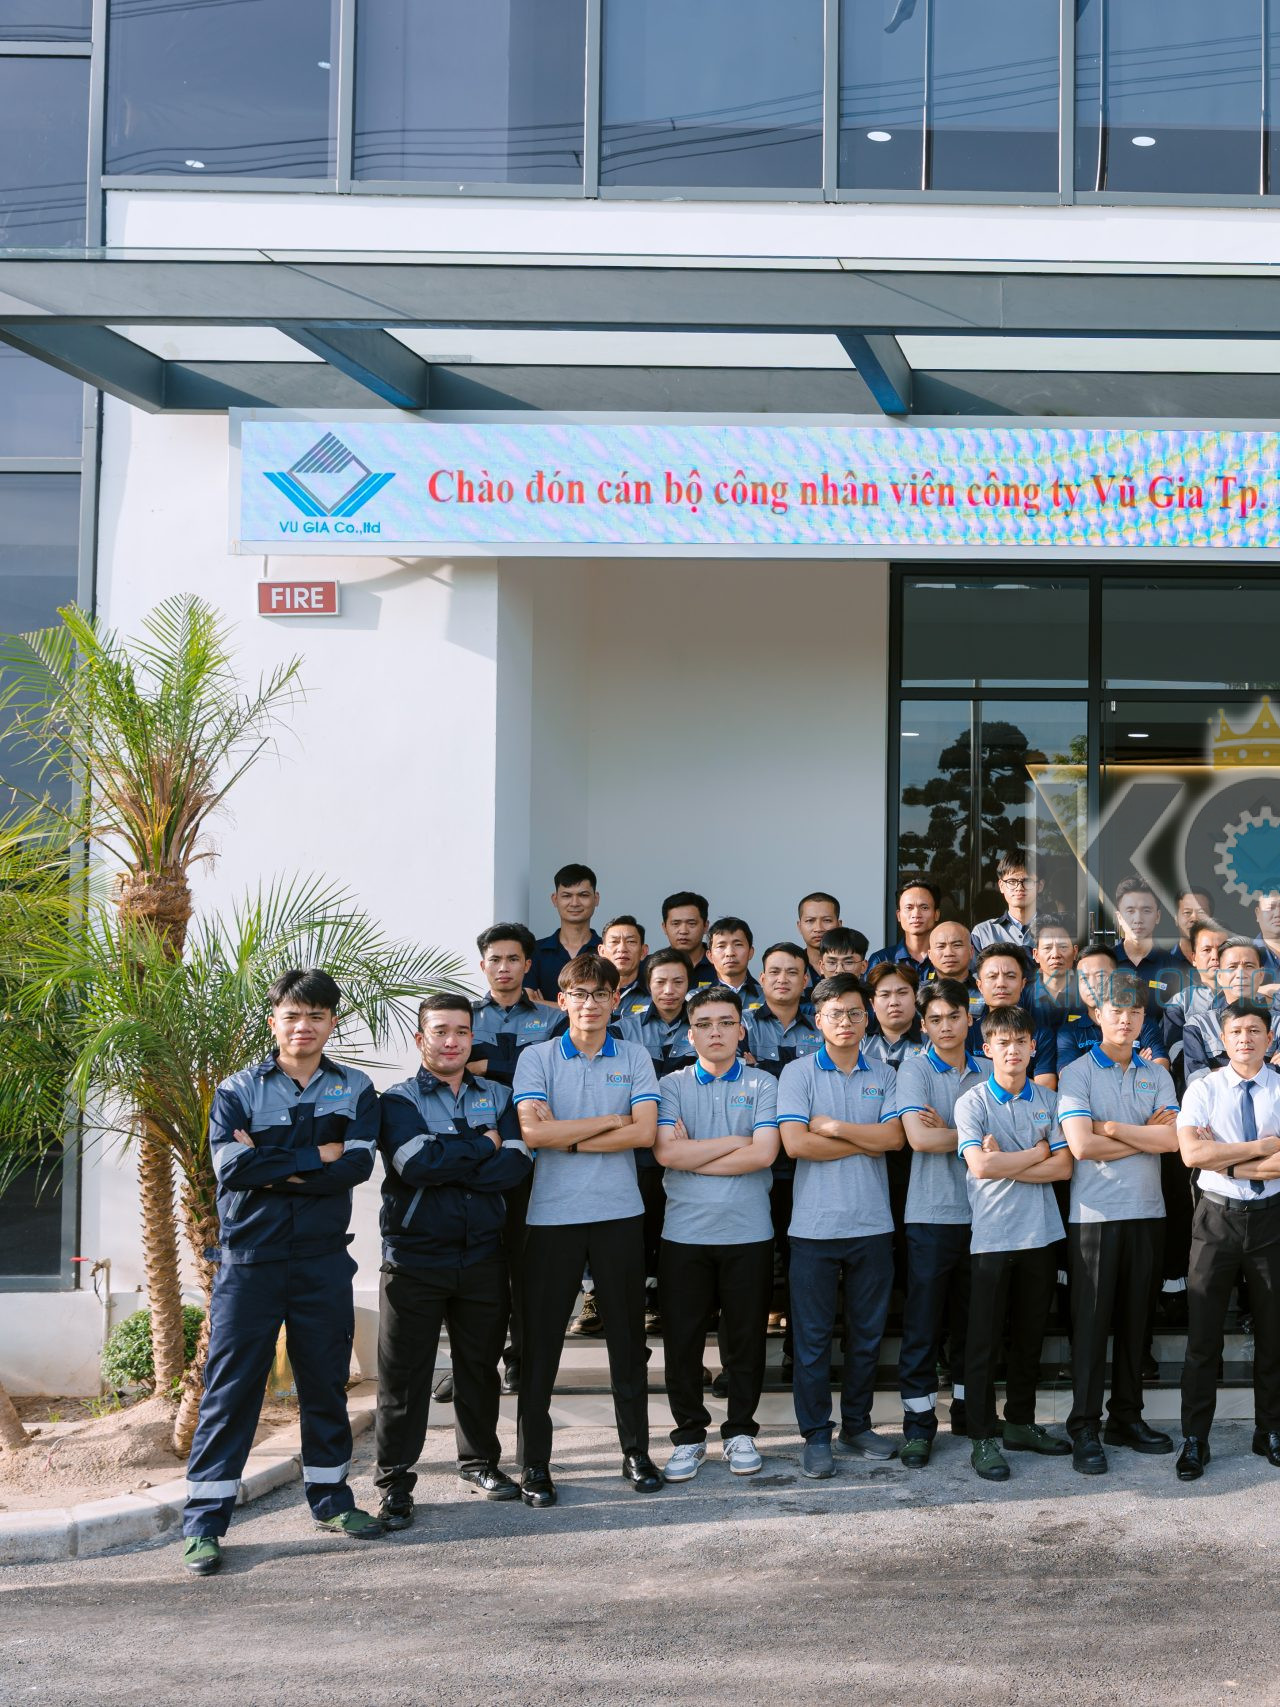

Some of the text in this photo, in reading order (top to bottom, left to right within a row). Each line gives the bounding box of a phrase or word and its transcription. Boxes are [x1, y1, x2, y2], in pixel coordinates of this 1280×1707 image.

[427, 469, 515, 503] Chào
[525, 469, 586, 505] đón
[597, 470, 653, 506] cán
[664, 469, 703, 513] bộ
[714, 469, 789, 515] công
[800, 470, 879, 506] nhân
[890, 470, 955, 507] viên
[967, 471, 1041, 517] công
[1051, 477, 1082, 517] ty
[1091, 474, 1137, 508] Vũ
[1149, 475, 1204, 509] Gia
[1214, 475, 1268, 519] Tp.
[279, 521, 299, 533] VU
[303, 521, 330, 534] GIA
[271, 587, 324, 609] FIRE
[606, 1074, 631, 1083] KOM
[325, 1087, 352, 1096] KOM
[731, 1096, 754, 1105] KOM
